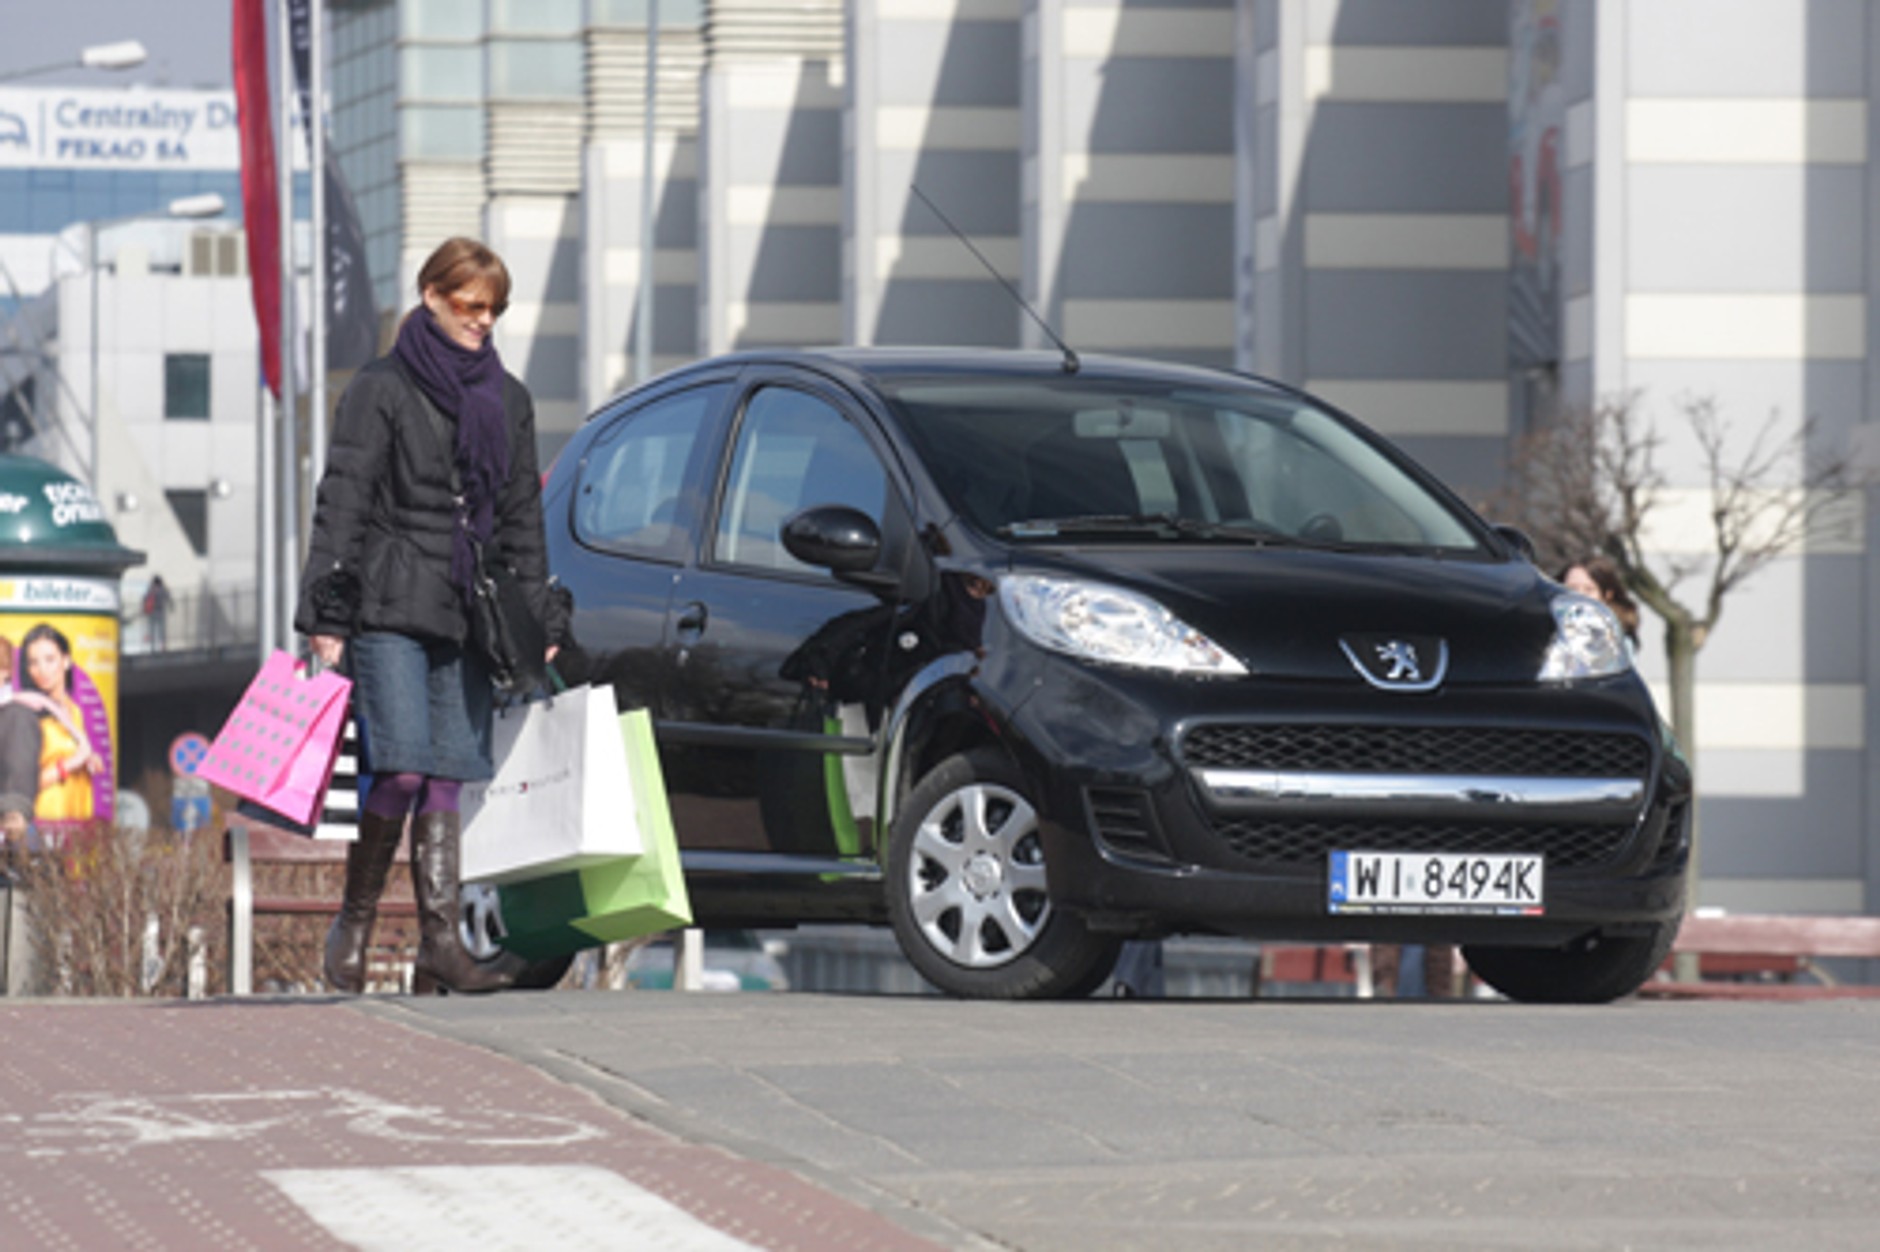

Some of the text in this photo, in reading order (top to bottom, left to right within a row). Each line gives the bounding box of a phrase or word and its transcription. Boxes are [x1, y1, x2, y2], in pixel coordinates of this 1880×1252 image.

[55, 98, 196, 136] Centralny
[57, 138, 188, 161] PEKAO SA
[1355, 857, 1537, 900] WI 8494K
